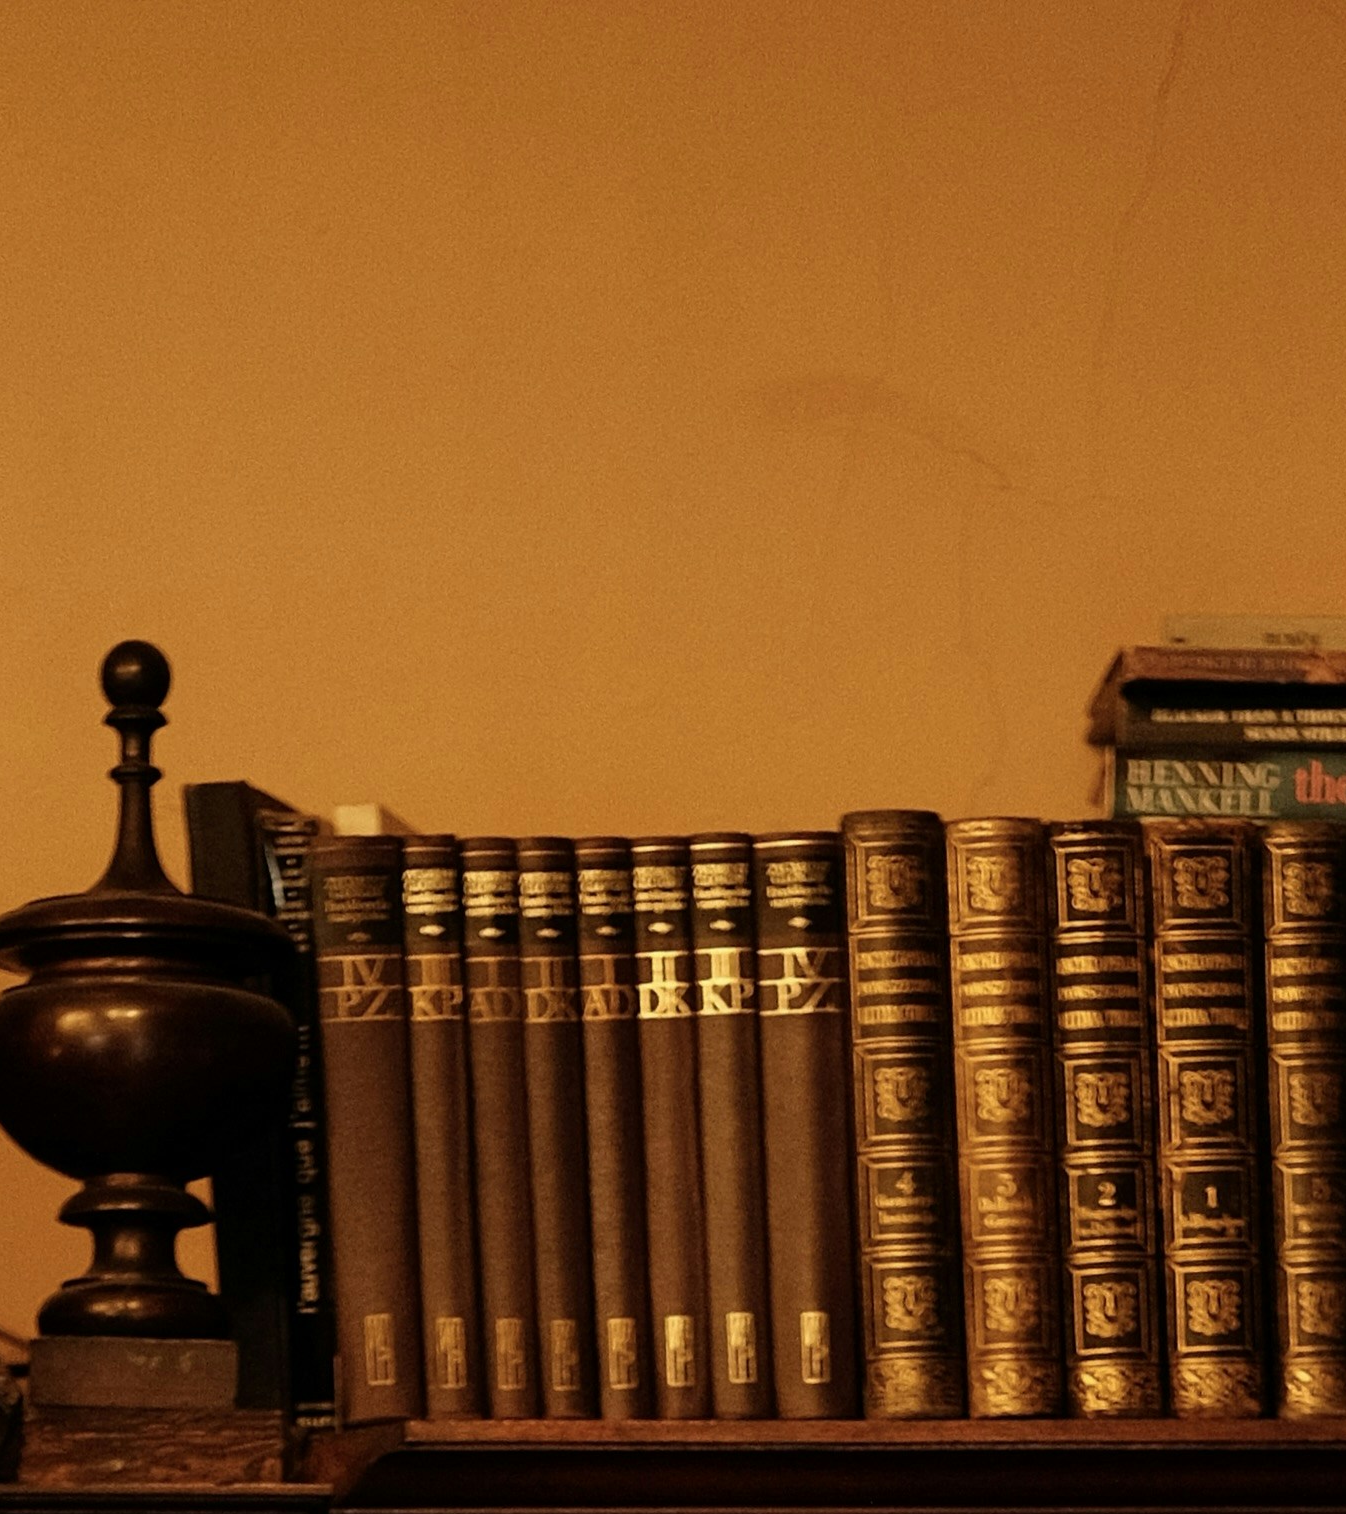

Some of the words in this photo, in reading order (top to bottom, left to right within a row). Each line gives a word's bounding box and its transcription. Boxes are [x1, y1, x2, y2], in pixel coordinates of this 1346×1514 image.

[1127, 759, 1281, 787] HENNING
[1127, 788, 1279, 815] MANKELL
[698, 980, 754, 1014] KP
[778, 981, 830, 1013] PZ
[290, 1138, 321, 1184] que
[895, 1171, 918, 1196] 4
[1097, 1181, 1118, 1206] 2
[1203, 1184, 1219, 1208] 1
